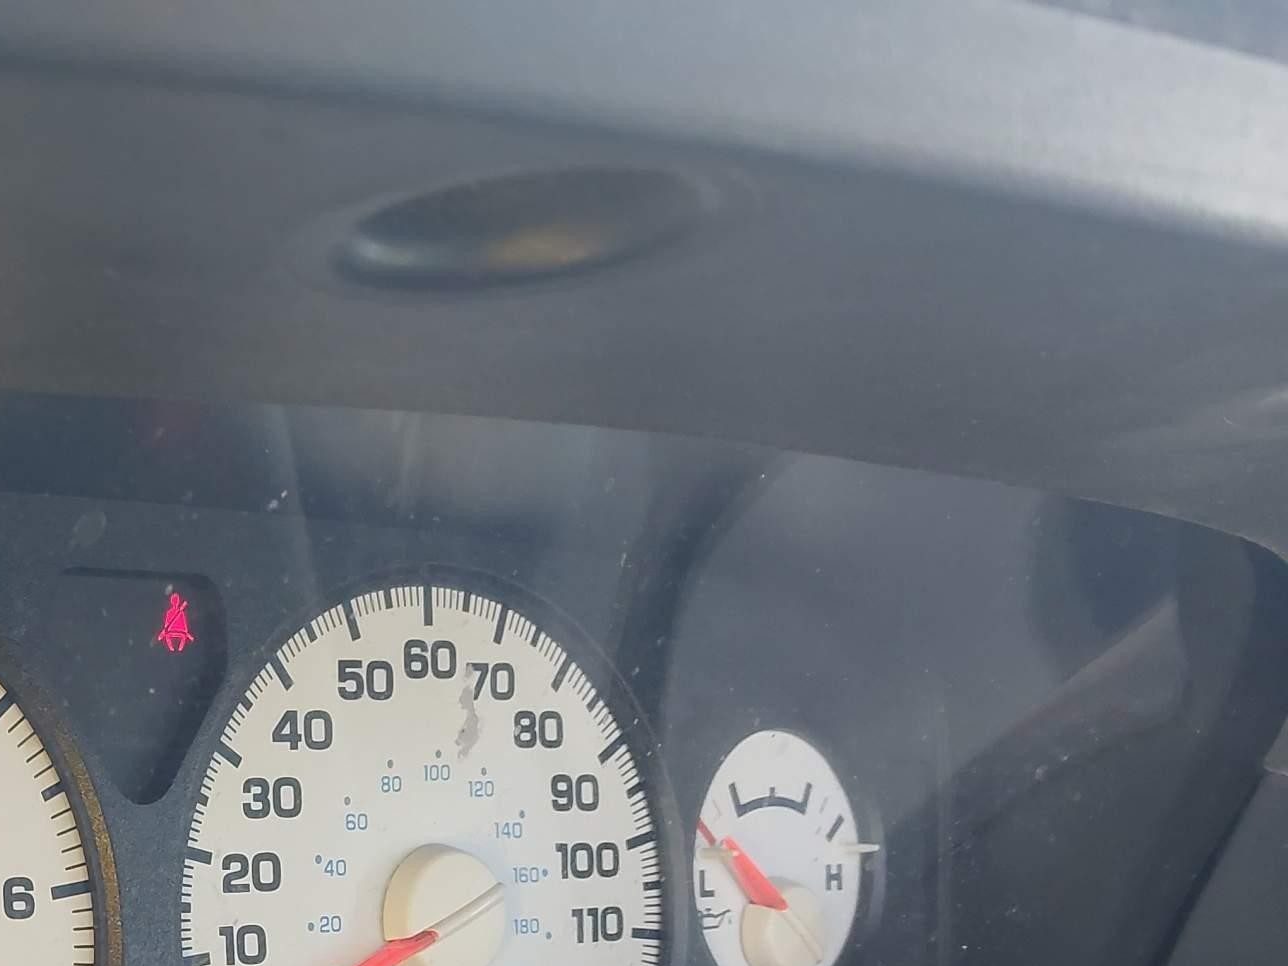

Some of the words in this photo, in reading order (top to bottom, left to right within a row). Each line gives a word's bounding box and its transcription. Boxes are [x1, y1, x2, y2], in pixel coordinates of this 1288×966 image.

[403, 639, 457, 680] 60
[337, 659, 394, 701] 50
[469, 662, 515, 701] 70
[271, 709, 333, 751] 40
[513, 710, 564, 749] 80
[380, 775, 402, 794] 80
[423, 764, 451, 782] 100
[468, 780, 495, 798] 120
[242, 776, 303, 820] 30
[550, 773, 600, 812] 90
[345, 813, 368, 831] 60
[493, 822, 523, 839] 140
[221, 852, 282, 894] 20
[323, 859, 347, 877] 40
[512, 866, 540, 884] 160
[555, 841, 620, 880] 100
[825, 863, 843, 891] H
[2, 876, 36, 920] 6
[699, 869, 715, 898] L
[319, 915, 342, 933] 20
[513, 918, 540, 935] 180
[571, 906, 624, 944] 110
[218, 924, 267, 966] 10
